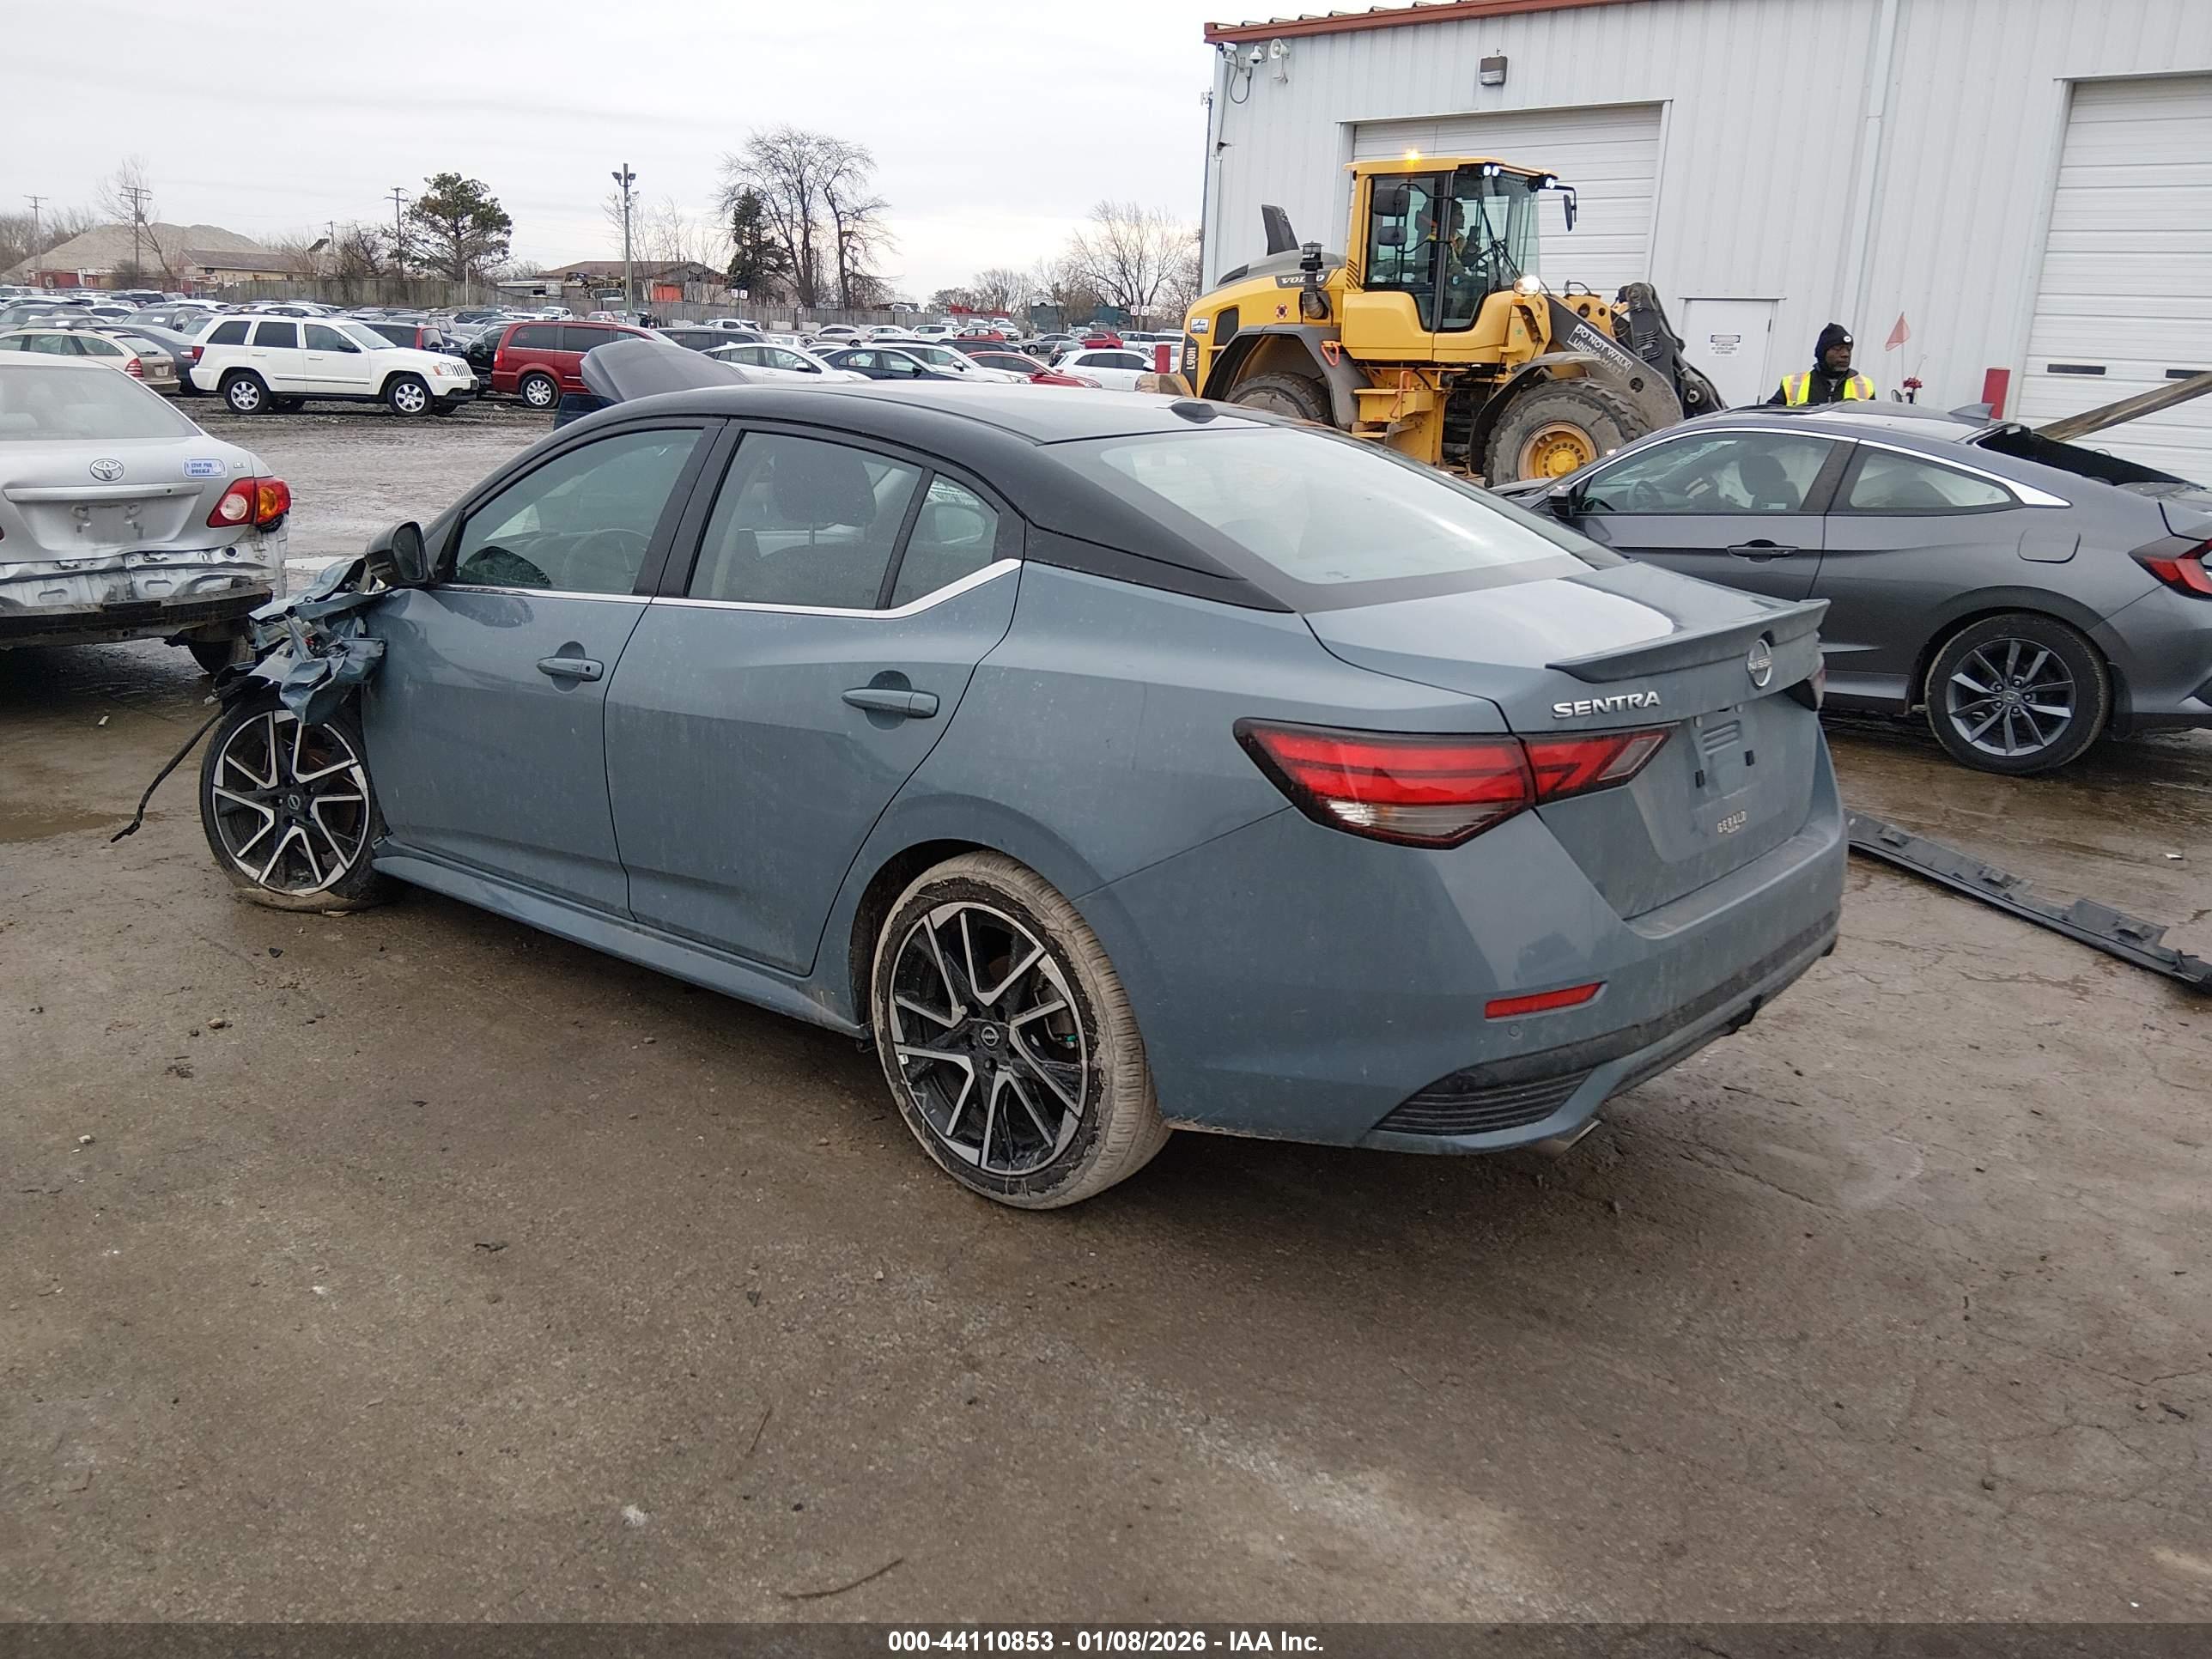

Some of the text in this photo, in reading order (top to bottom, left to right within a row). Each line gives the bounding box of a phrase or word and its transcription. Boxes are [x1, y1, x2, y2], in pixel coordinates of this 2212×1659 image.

[1280, 274, 1326, 284] VOLO
[1186, 347, 1196, 370] L90H
[1574, 325, 1632, 367] DO NOT WALK
[1552, 690, 1662, 720] SENTRA
